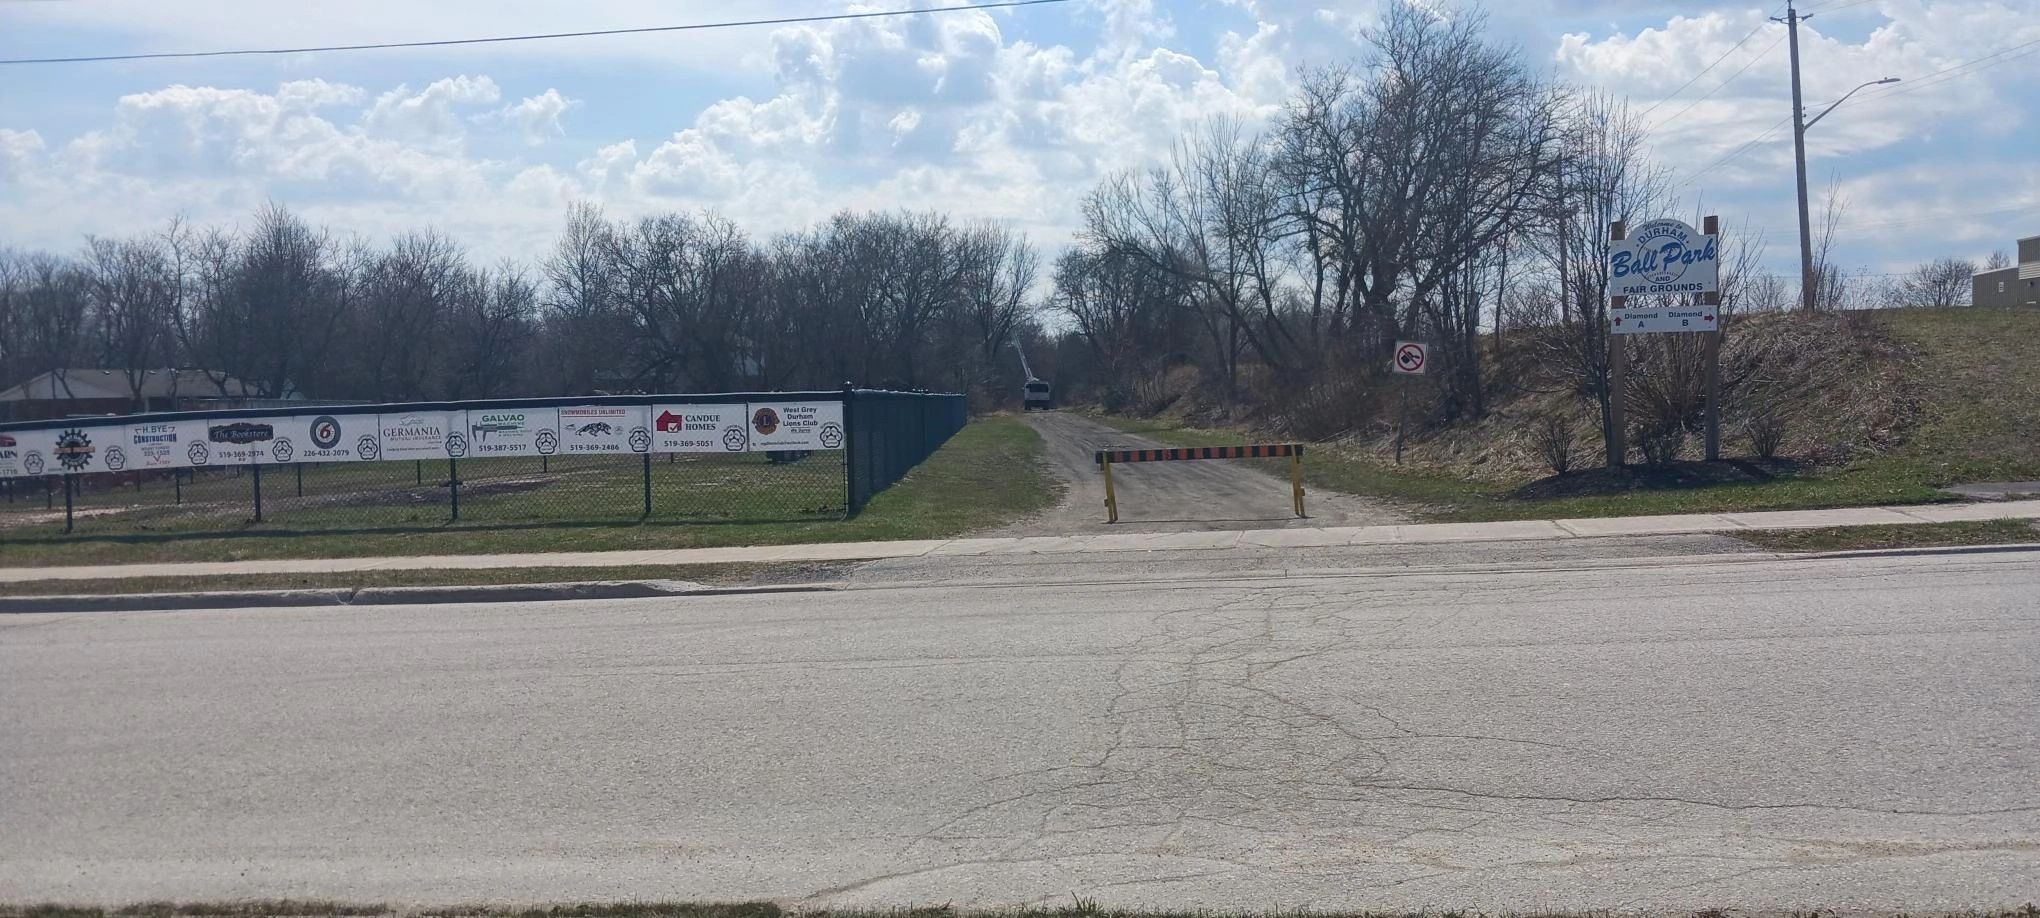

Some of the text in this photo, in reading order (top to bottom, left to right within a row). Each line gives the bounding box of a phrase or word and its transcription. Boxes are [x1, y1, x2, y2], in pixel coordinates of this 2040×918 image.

[1638, 227, 1688, 244] DURHAM
[1611, 238, 1716, 278] Ball Park
[1623, 282, 1703, 294] FAIR GROUNDS
[1624, 312, 1658, 320] Diamond
[1637, 320, 1645, 328] A
[1681, 319, 1689, 327] B
[801, 406, 817, 414] Grey
[482, 414, 525, 422] GALVAO
[151, 424, 168, 433] BYE
[320, 423, 331, 439] 6
[383, 427, 441, 437] GERMANIA
[133, 433, 177, 444] CONSTRUCTION
[304, 449, 350, 457] 226-432-2079
